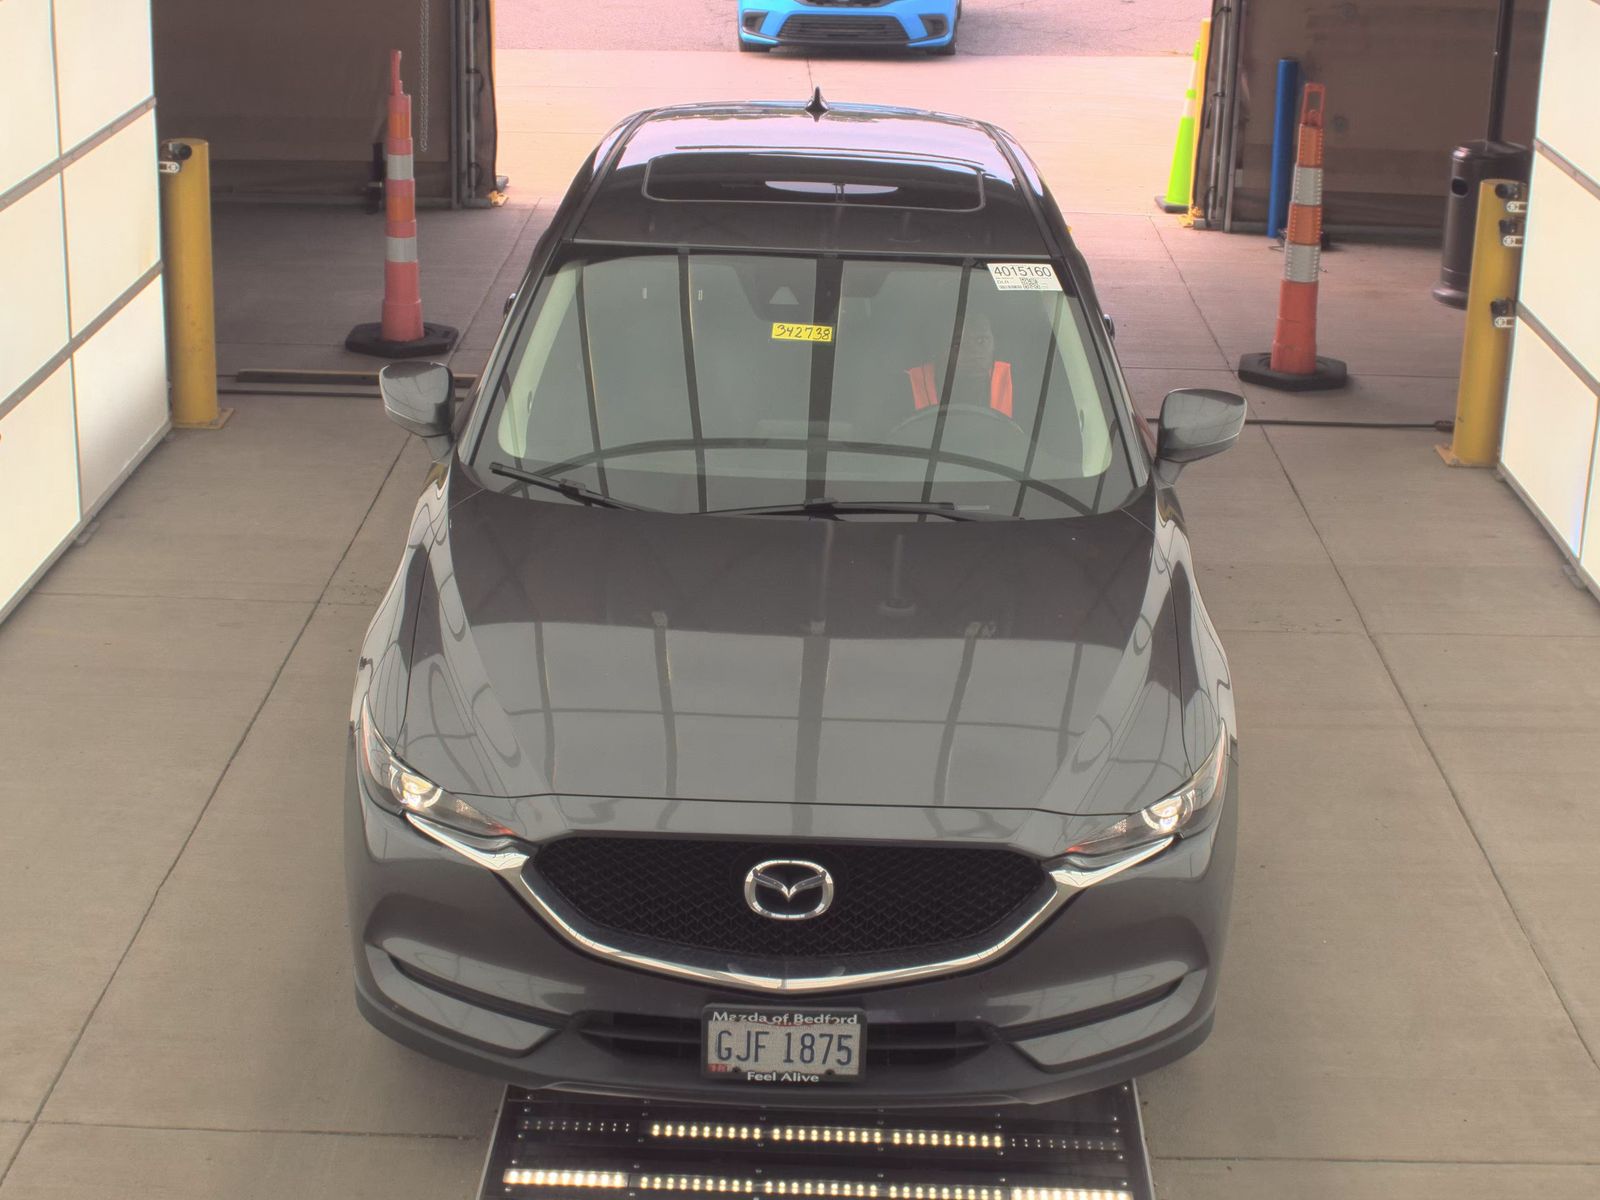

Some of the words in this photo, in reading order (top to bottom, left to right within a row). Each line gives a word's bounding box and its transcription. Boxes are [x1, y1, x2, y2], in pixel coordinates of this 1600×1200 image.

[994, 265, 1052, 277] 4015160
[775, 324, 831, 340] 342738
[712, 1011, 767, 1023] Mazda
[772, 1013, 790, 1025] of
[793, 1013, 858, 1025] Bedford
[717, 1030, 770, 1063] GJF
[783, 1032, 853, 1066] 1875
[747, 1071, 777, 1082] Feel
[780, 1072, 820, 1083] Alive
